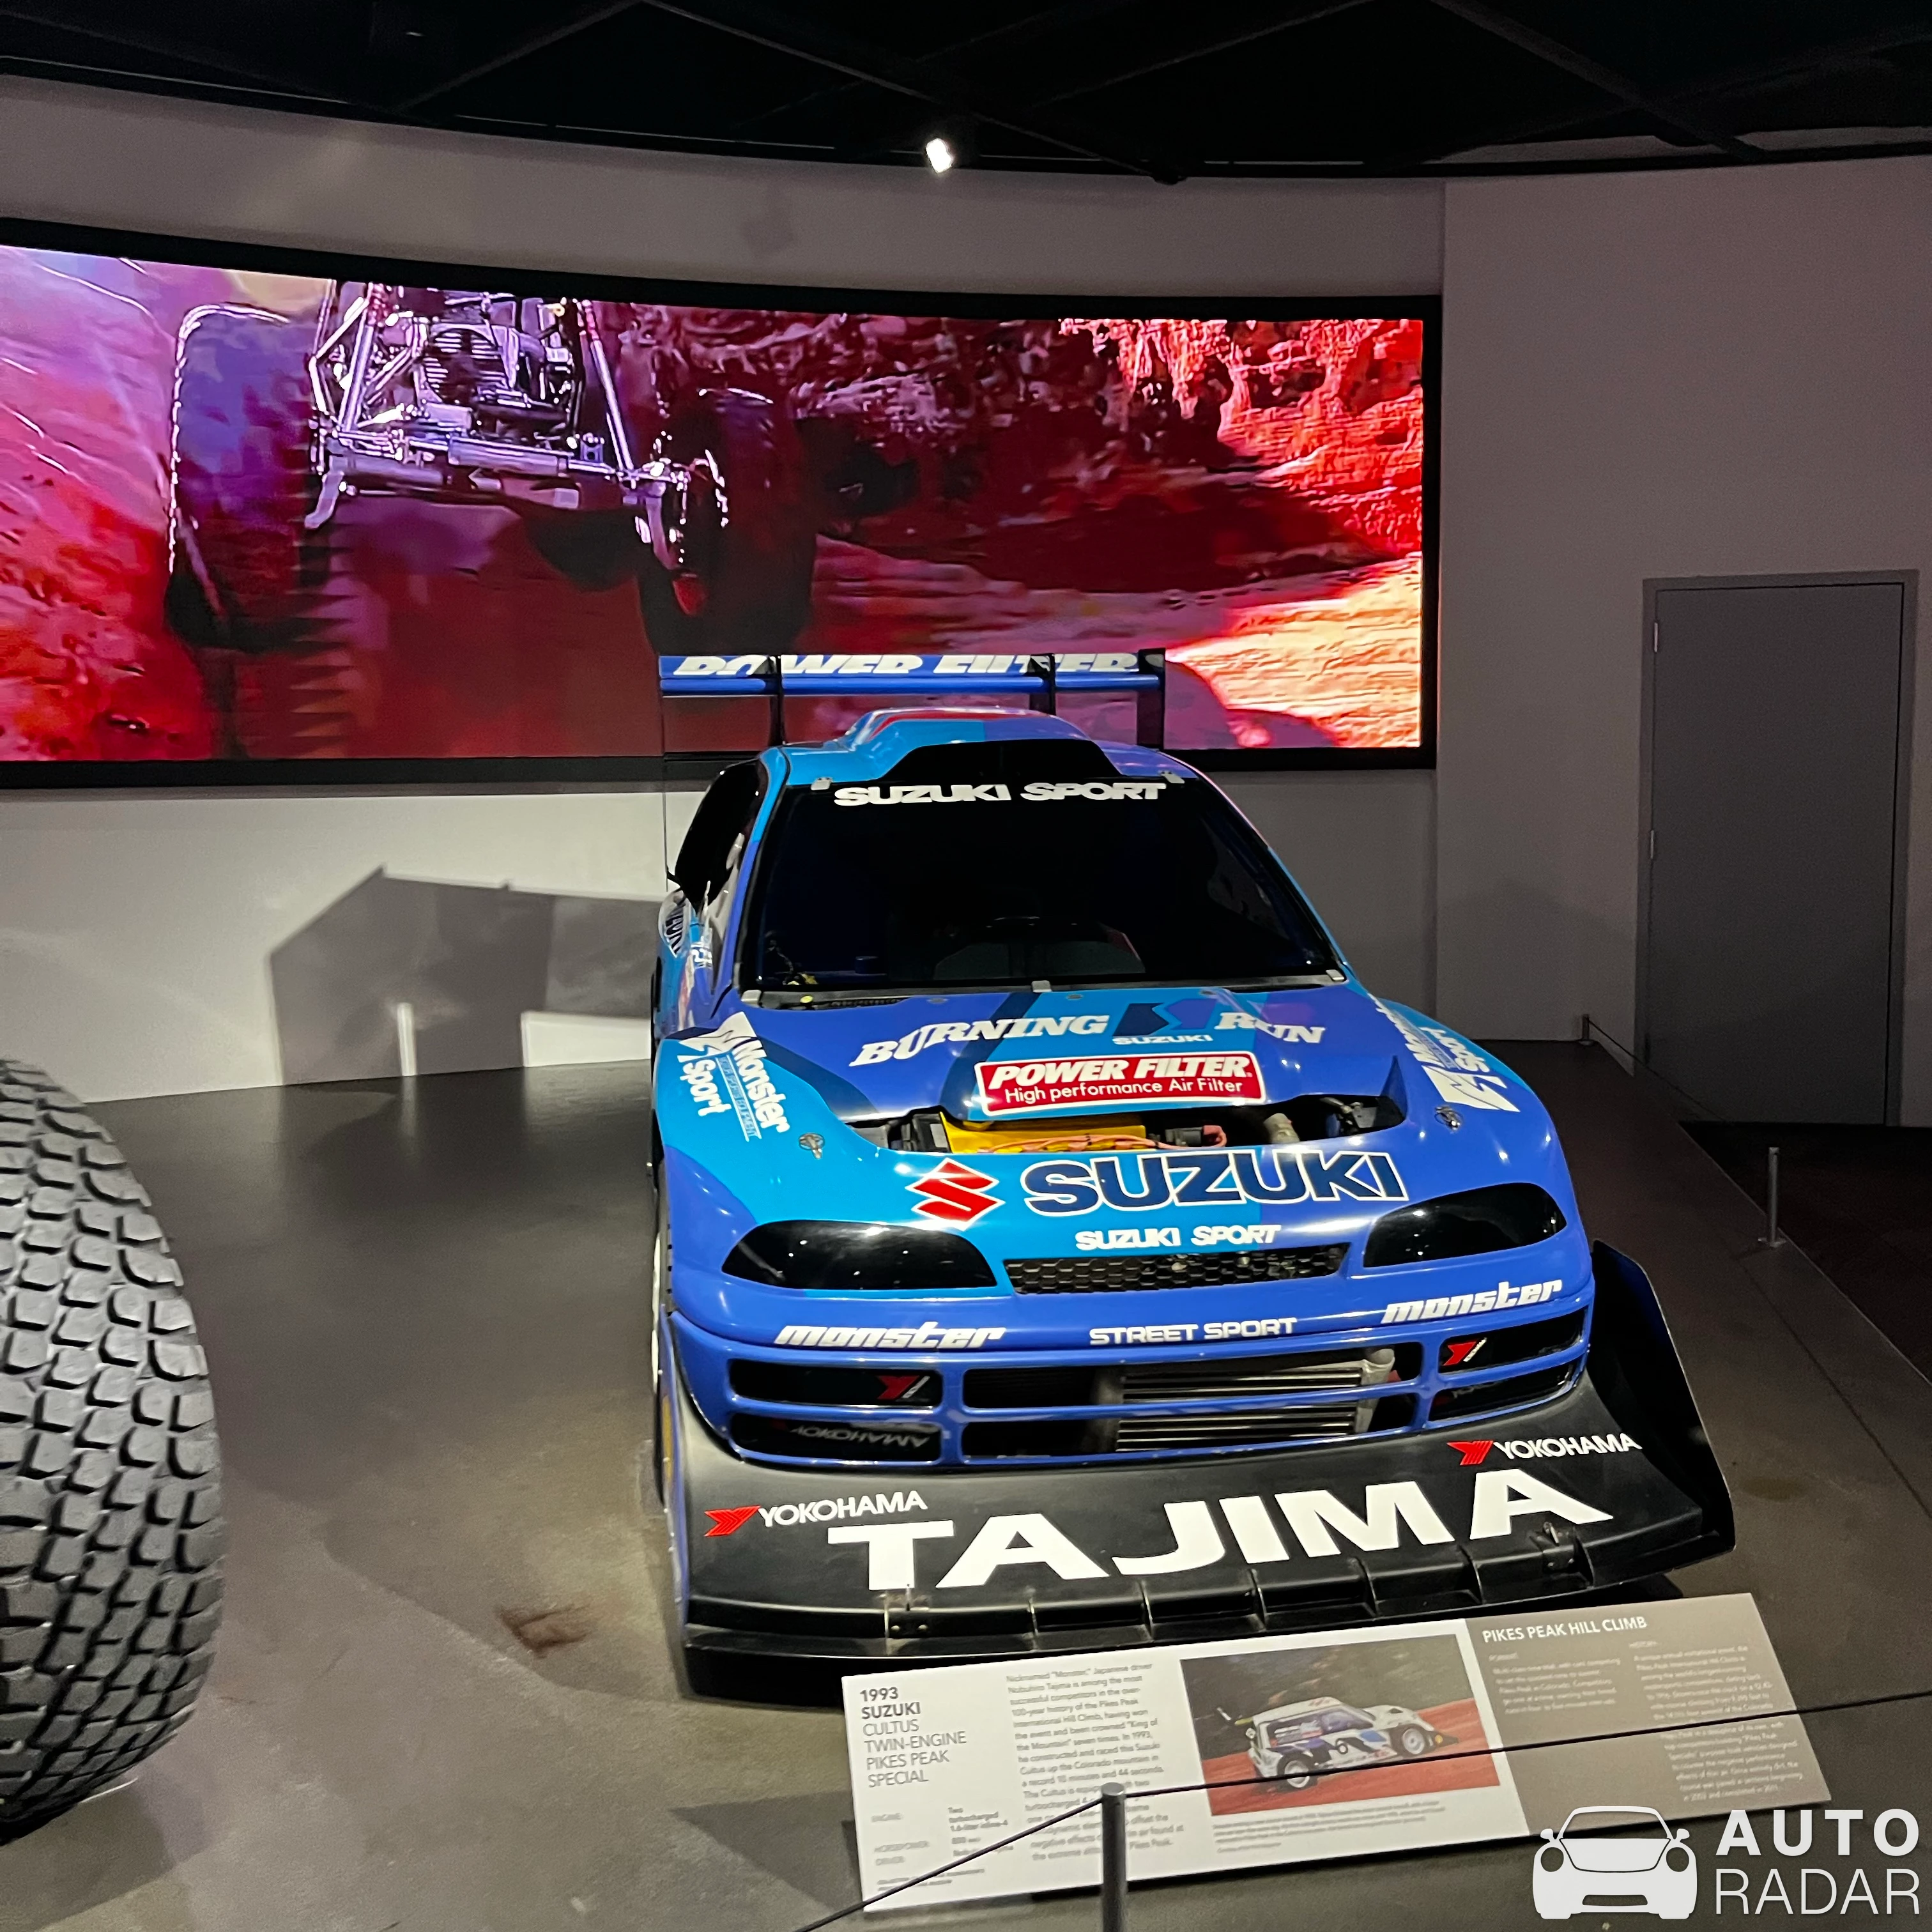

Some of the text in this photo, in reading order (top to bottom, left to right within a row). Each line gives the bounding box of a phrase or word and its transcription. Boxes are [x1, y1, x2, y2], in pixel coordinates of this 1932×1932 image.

[834, 783, 1166, 806] SUZUKI SPORT
[849, 1012, 1326, 1067] BURNING RUN
[1112, 1034, 1213, 1046] SUZUKI
[988, 1054, 1250, 1089] POWER FILTER
[680, 1058, 732, 1117] Sport
[732, 1039, 790, 1133] Monster
[1005, 1077, 1243, 1104] High performance Air Filter
[1021, 1150, 1408, 1216] SUZUKI
[1075, 1224, 1281, 1250] SUZUKI SPORT
[1380, 1279, 1563, 1325] monster
[774, 1321, 1007, 1349] monster
[1089, 1317, 1298, 1345] STREET SPORT
[1496, 1433, 1643, 1460] YOKOHAMA
[758, 1490, 928, 1528] YOKOHAMA
[827, 1468, 1613, 1591] TAJIMA
[1482, 1616, 1647, 1643] PIKES PEAK HILL CLIMB
[860, 1687, 899, 1702] 1993
[861, 1702, 921, 1719] SUZUKI
[862, 1719, 919, 1736] CULTUS
[864, 1731, 967, 1752] TWIN-ENGINE
[866, 1750, 949, 1770] PIKES PEAK
[868, 1770, 929, 1788] SPECIAL
